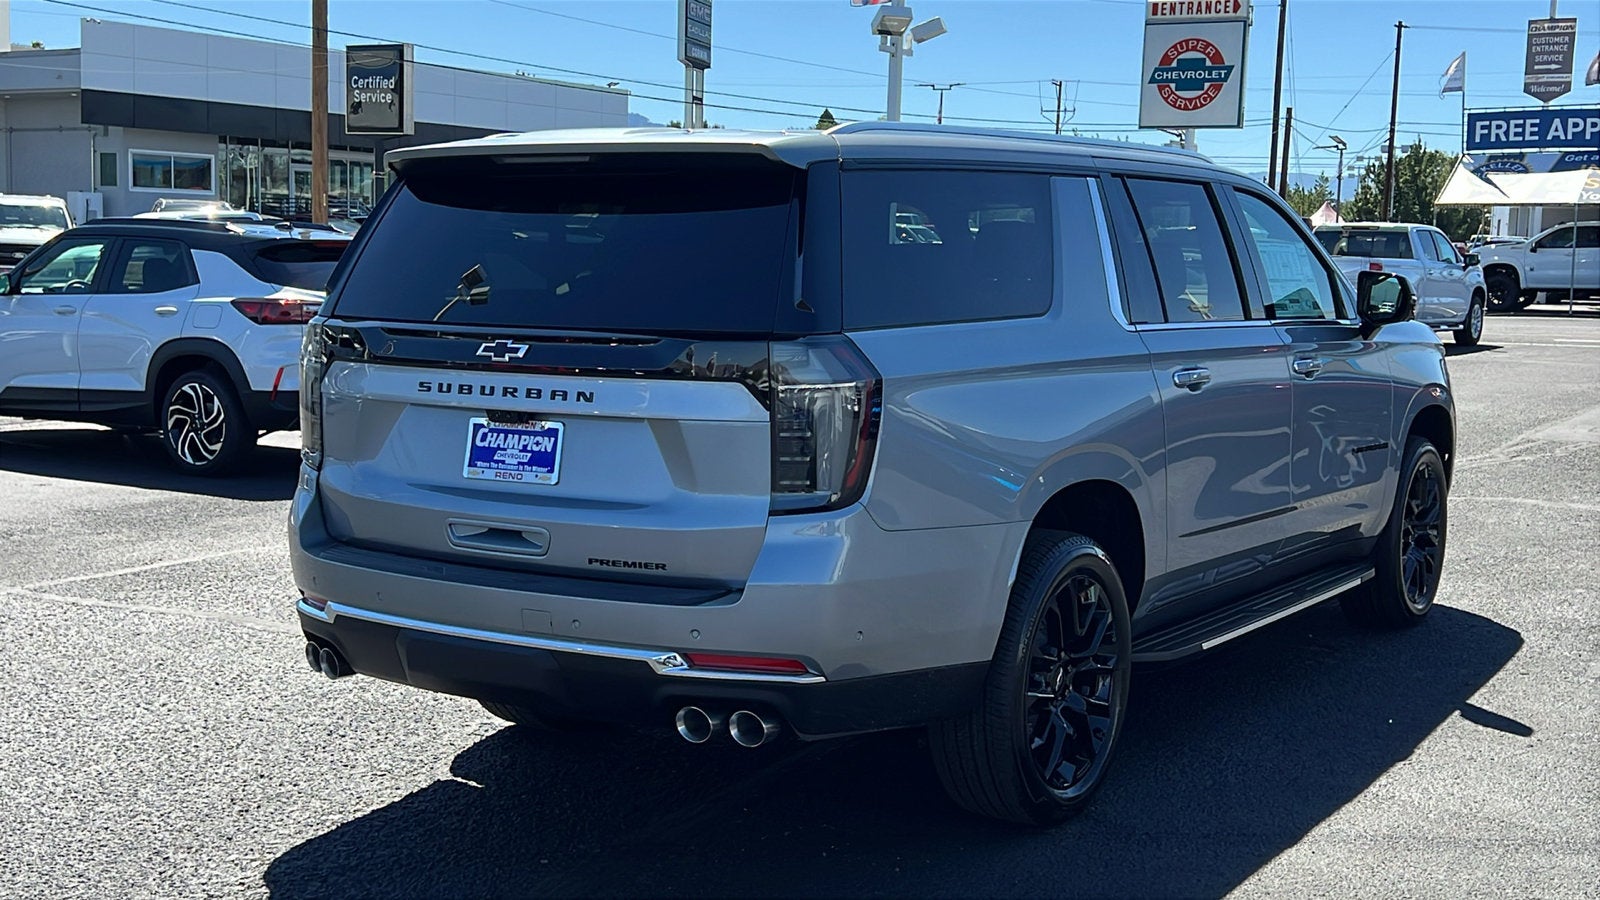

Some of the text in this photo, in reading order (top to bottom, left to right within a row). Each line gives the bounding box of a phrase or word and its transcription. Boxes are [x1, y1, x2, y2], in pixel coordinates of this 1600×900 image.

[690, 3, 710, 20] GMC
[1160, 0, 1230, 16] ENTRANCE
[1530, 24, 1576, 33] CHAMPION
[1532, 36, 1570, 44] CUSTOMER
[1167, 39, 1216, 59] SUPER
[1531, 45, 1569, 53] ENTRANCE
[351, 75, 395, 88] Certified
[1154, 70, 1227, 80] CHEVROLET
[1530, 84, 1566, 93] Welcome!
[353, 90, 393, 103] Service
[1161, 87, 1218, 110] SERVICE
[1475, 117, 1600, 143] FREE APP
[1564, 154, 1588, 162] Get
[1480, 162, 1526, 172] KELLEY
[418, 381, 594, 403] SUBURBAN
[475, 428, 555, 453] CHAMPION
[496, 452, 529, 461] CHEVROLET
[494, 471, 524, 480] RENO
[587, 557, 668, 571] PREMIER
